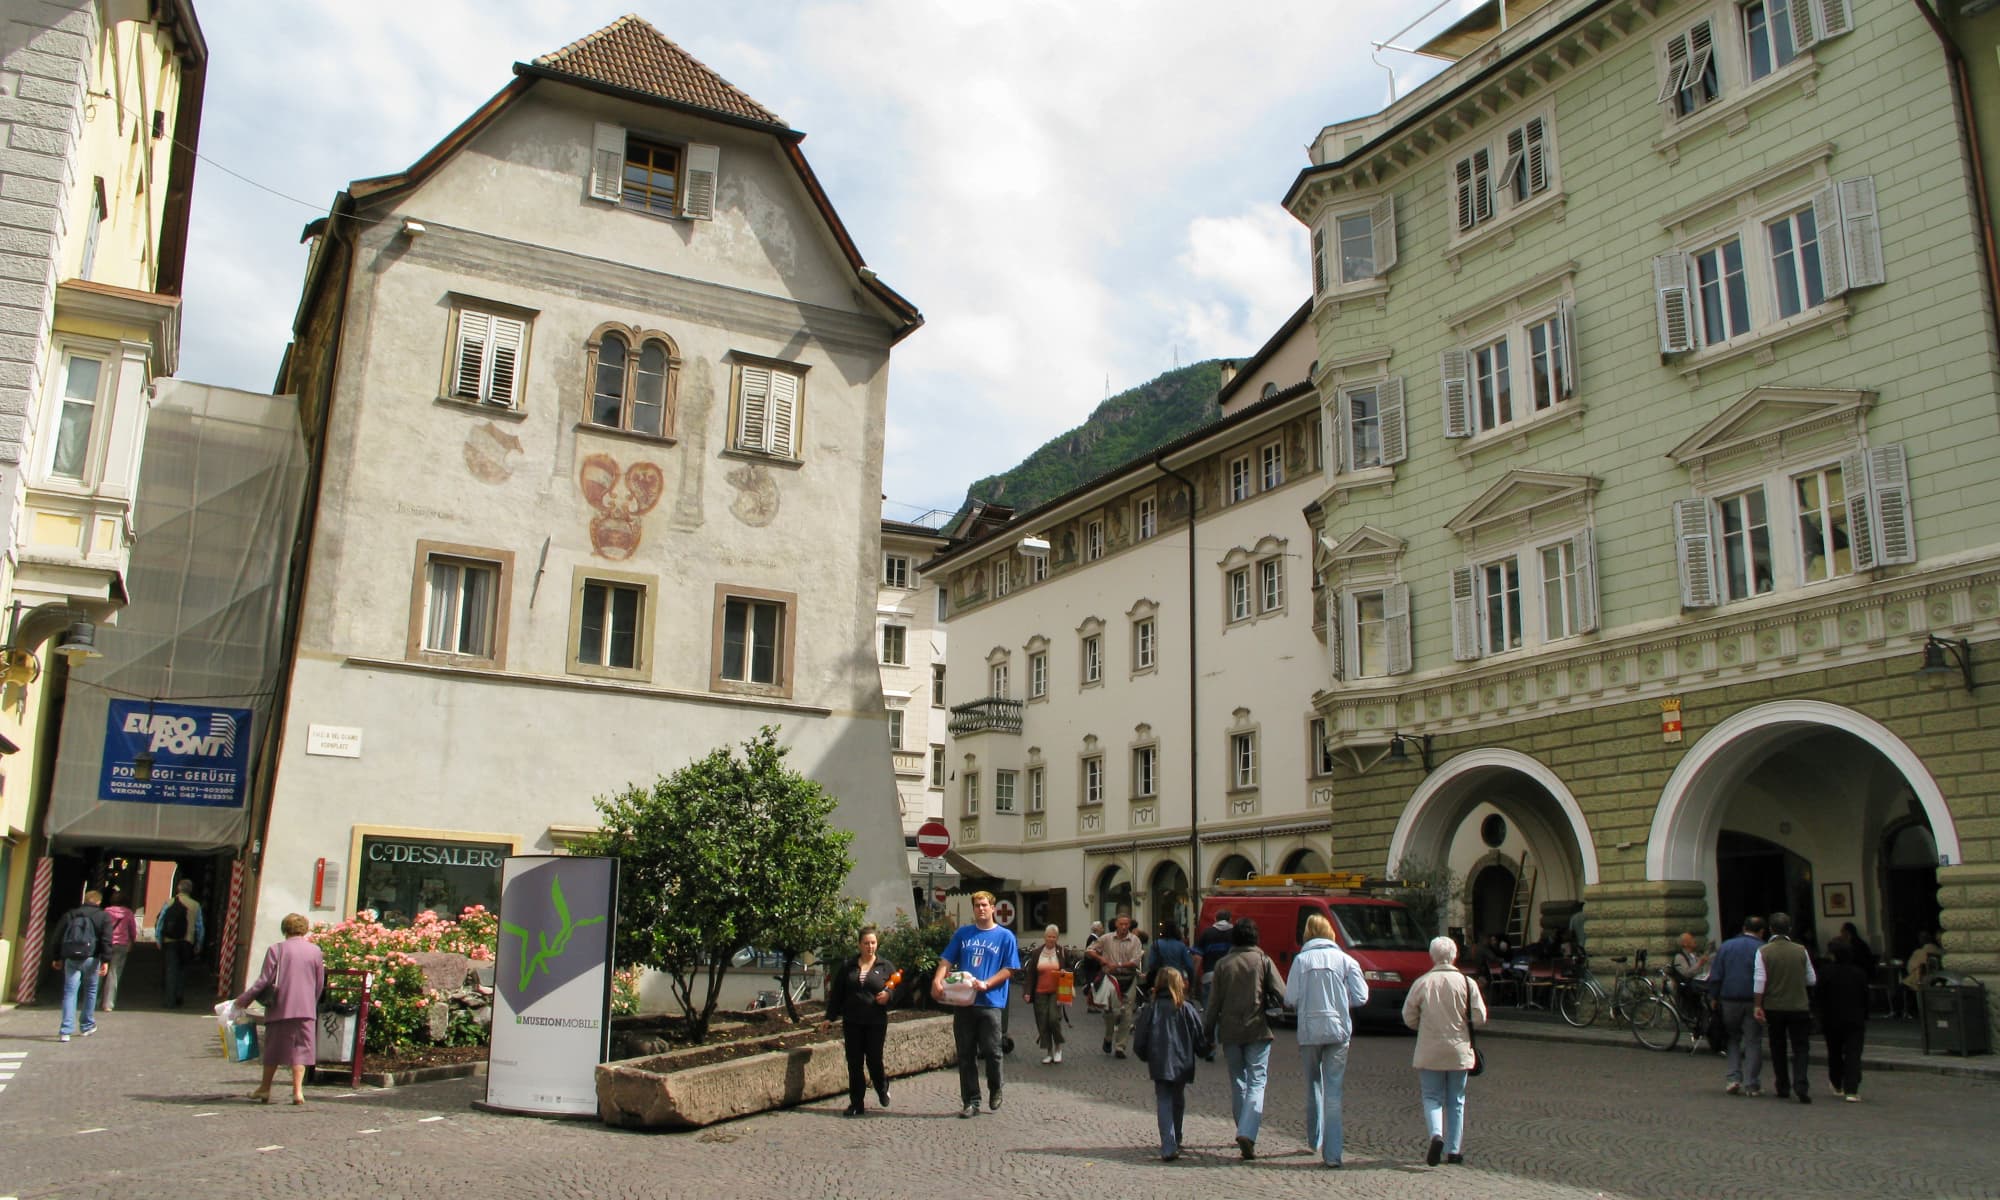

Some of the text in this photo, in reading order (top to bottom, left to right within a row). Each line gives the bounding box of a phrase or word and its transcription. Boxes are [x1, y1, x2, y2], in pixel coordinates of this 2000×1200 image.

[123, 713, 197, 735] EURO
[149, 732, 226, 757] PONT
[185, 769, 236, 783] GERÜSTE
[110, 788, 146, 796] VERONA
[111, 781, 152, 790] BOLZANO
[522, 1015, 599, 1029] MUSEIONMOBILE
